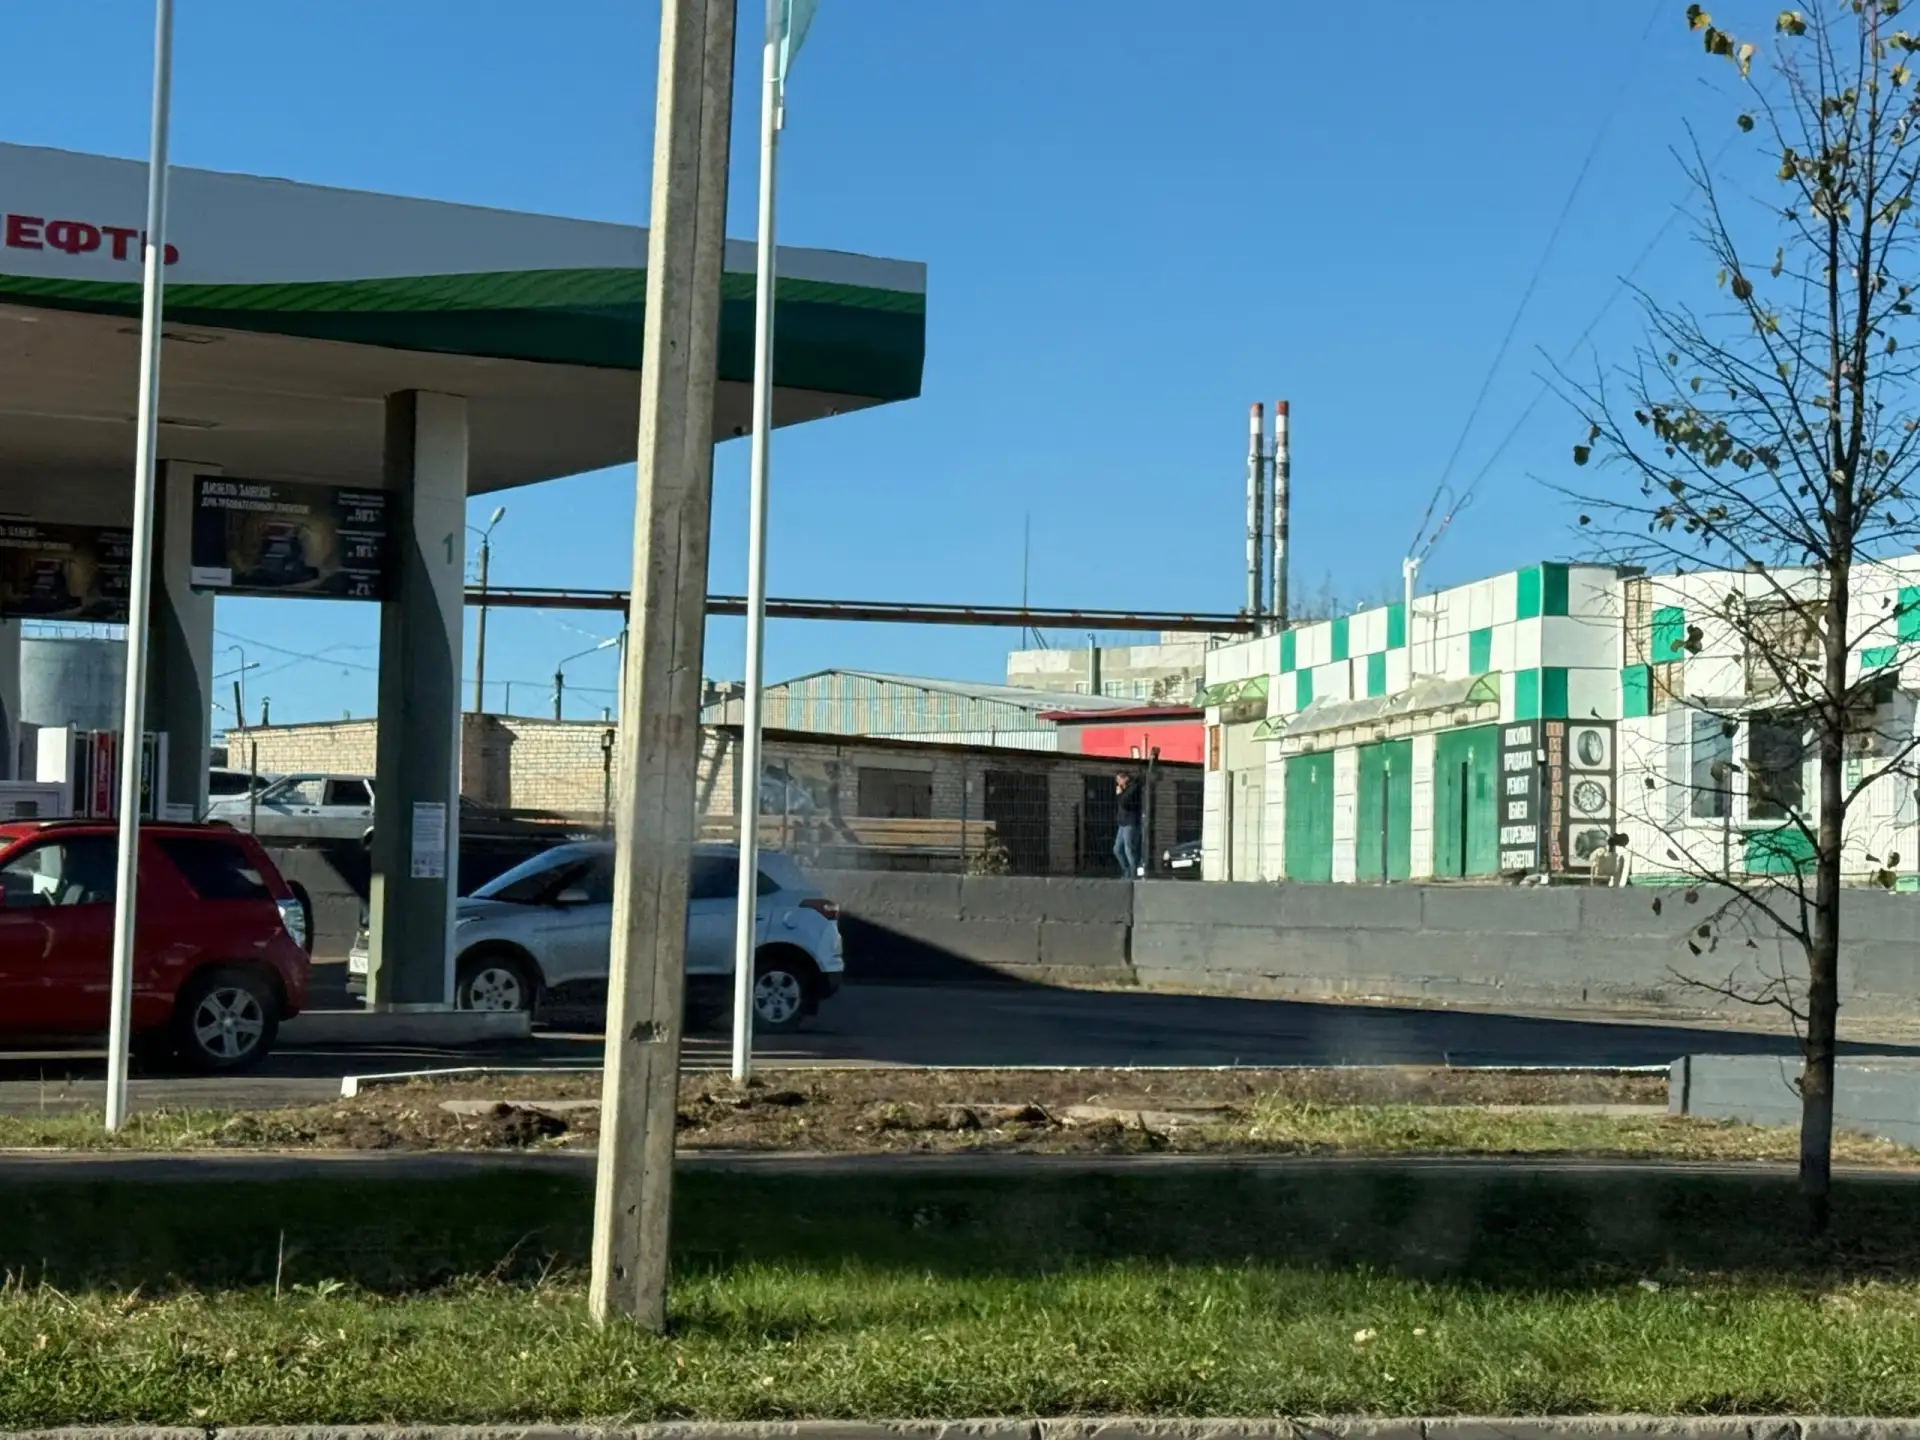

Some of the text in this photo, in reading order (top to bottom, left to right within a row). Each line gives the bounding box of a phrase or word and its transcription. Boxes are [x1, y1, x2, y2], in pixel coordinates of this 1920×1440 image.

[0, 213, 179, 265] ЕФТЬ
[443, 532, 453, 564] 1
[1507, 775, 1530, 796] РЕМОНТ
[1546, 722, 1565, 871] ШИНОМОНТАЖ
